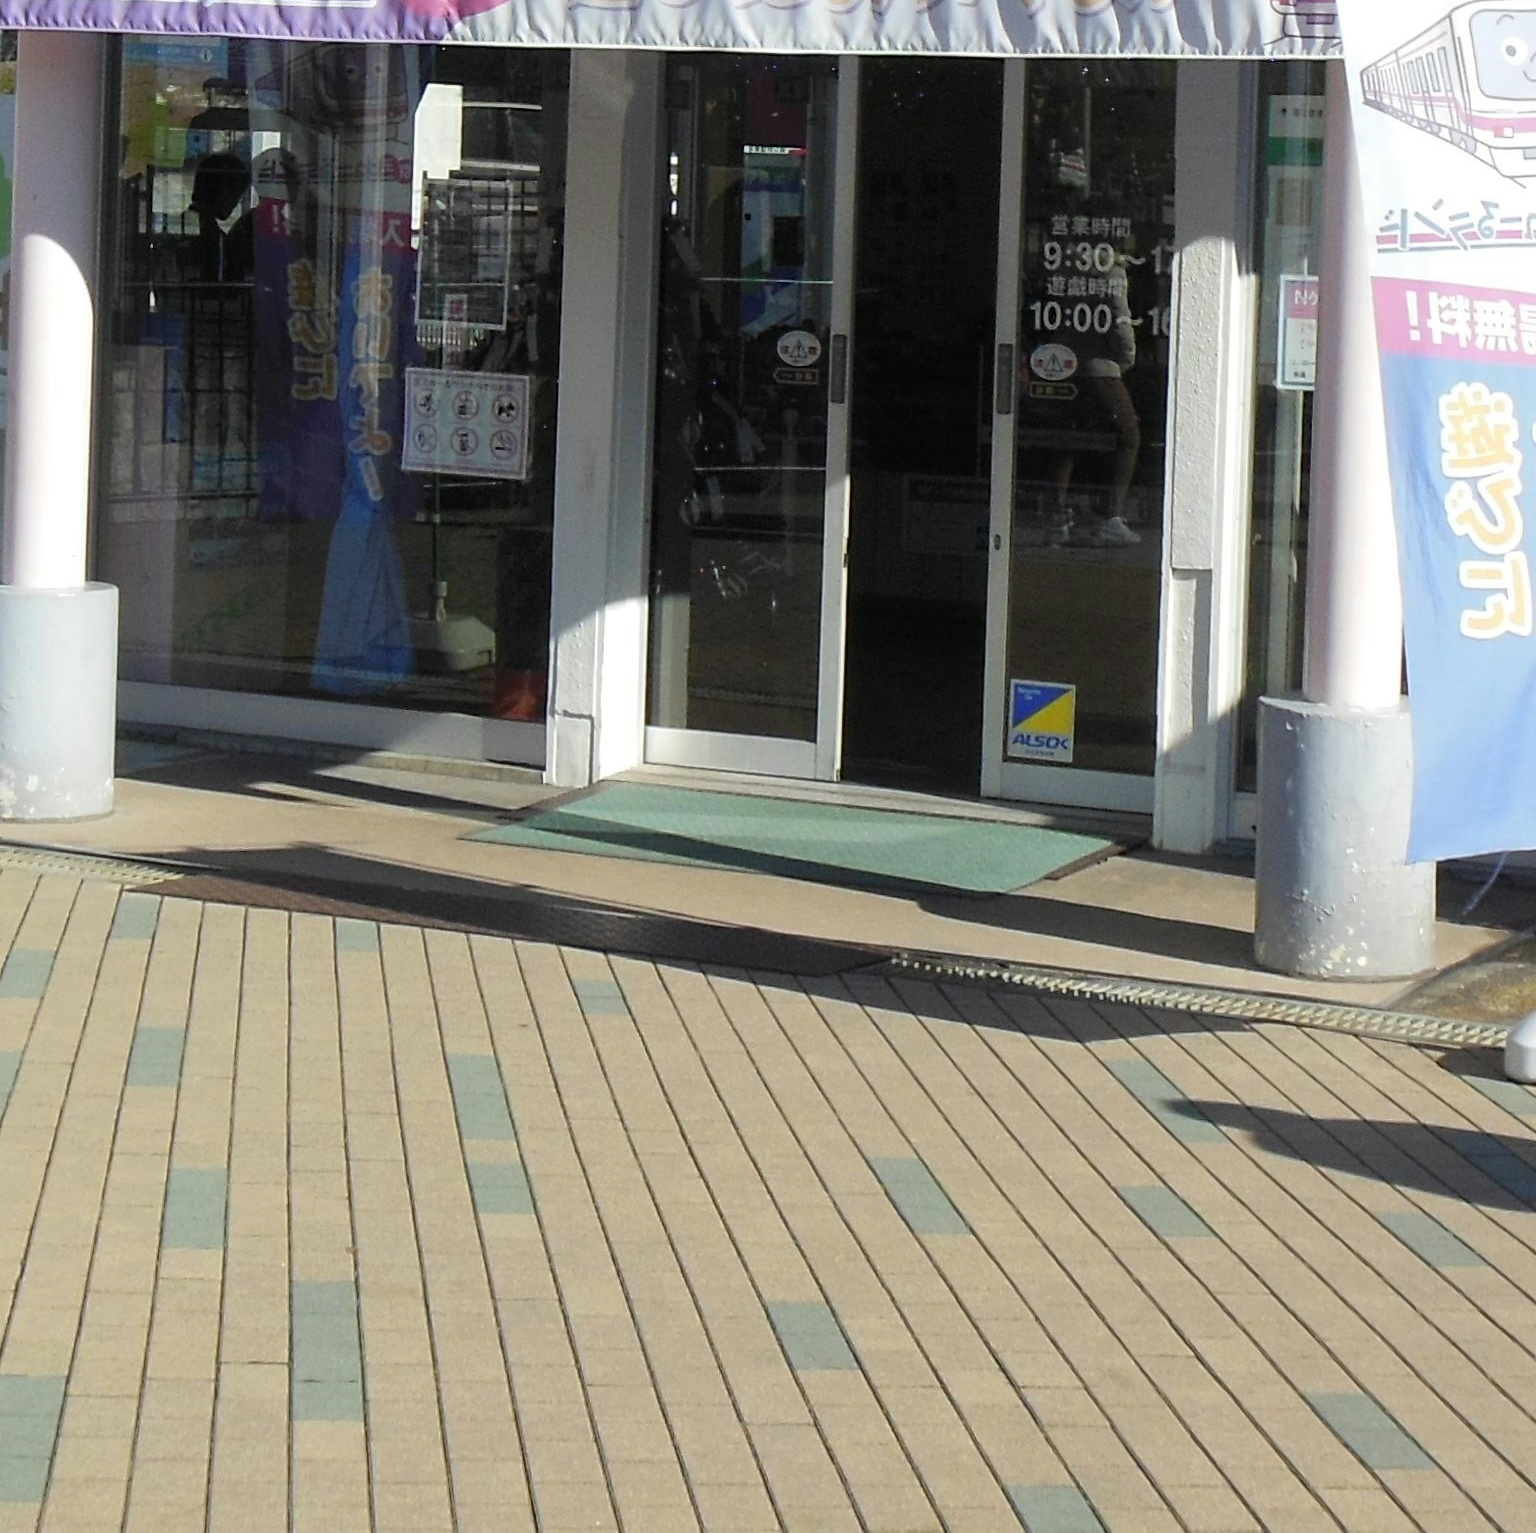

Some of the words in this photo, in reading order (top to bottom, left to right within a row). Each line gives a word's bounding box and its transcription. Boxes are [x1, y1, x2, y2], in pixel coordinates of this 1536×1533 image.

[1052, 215, 1131, 238] 営業時間
[1013, 733, 1072, 750] ALSOK
